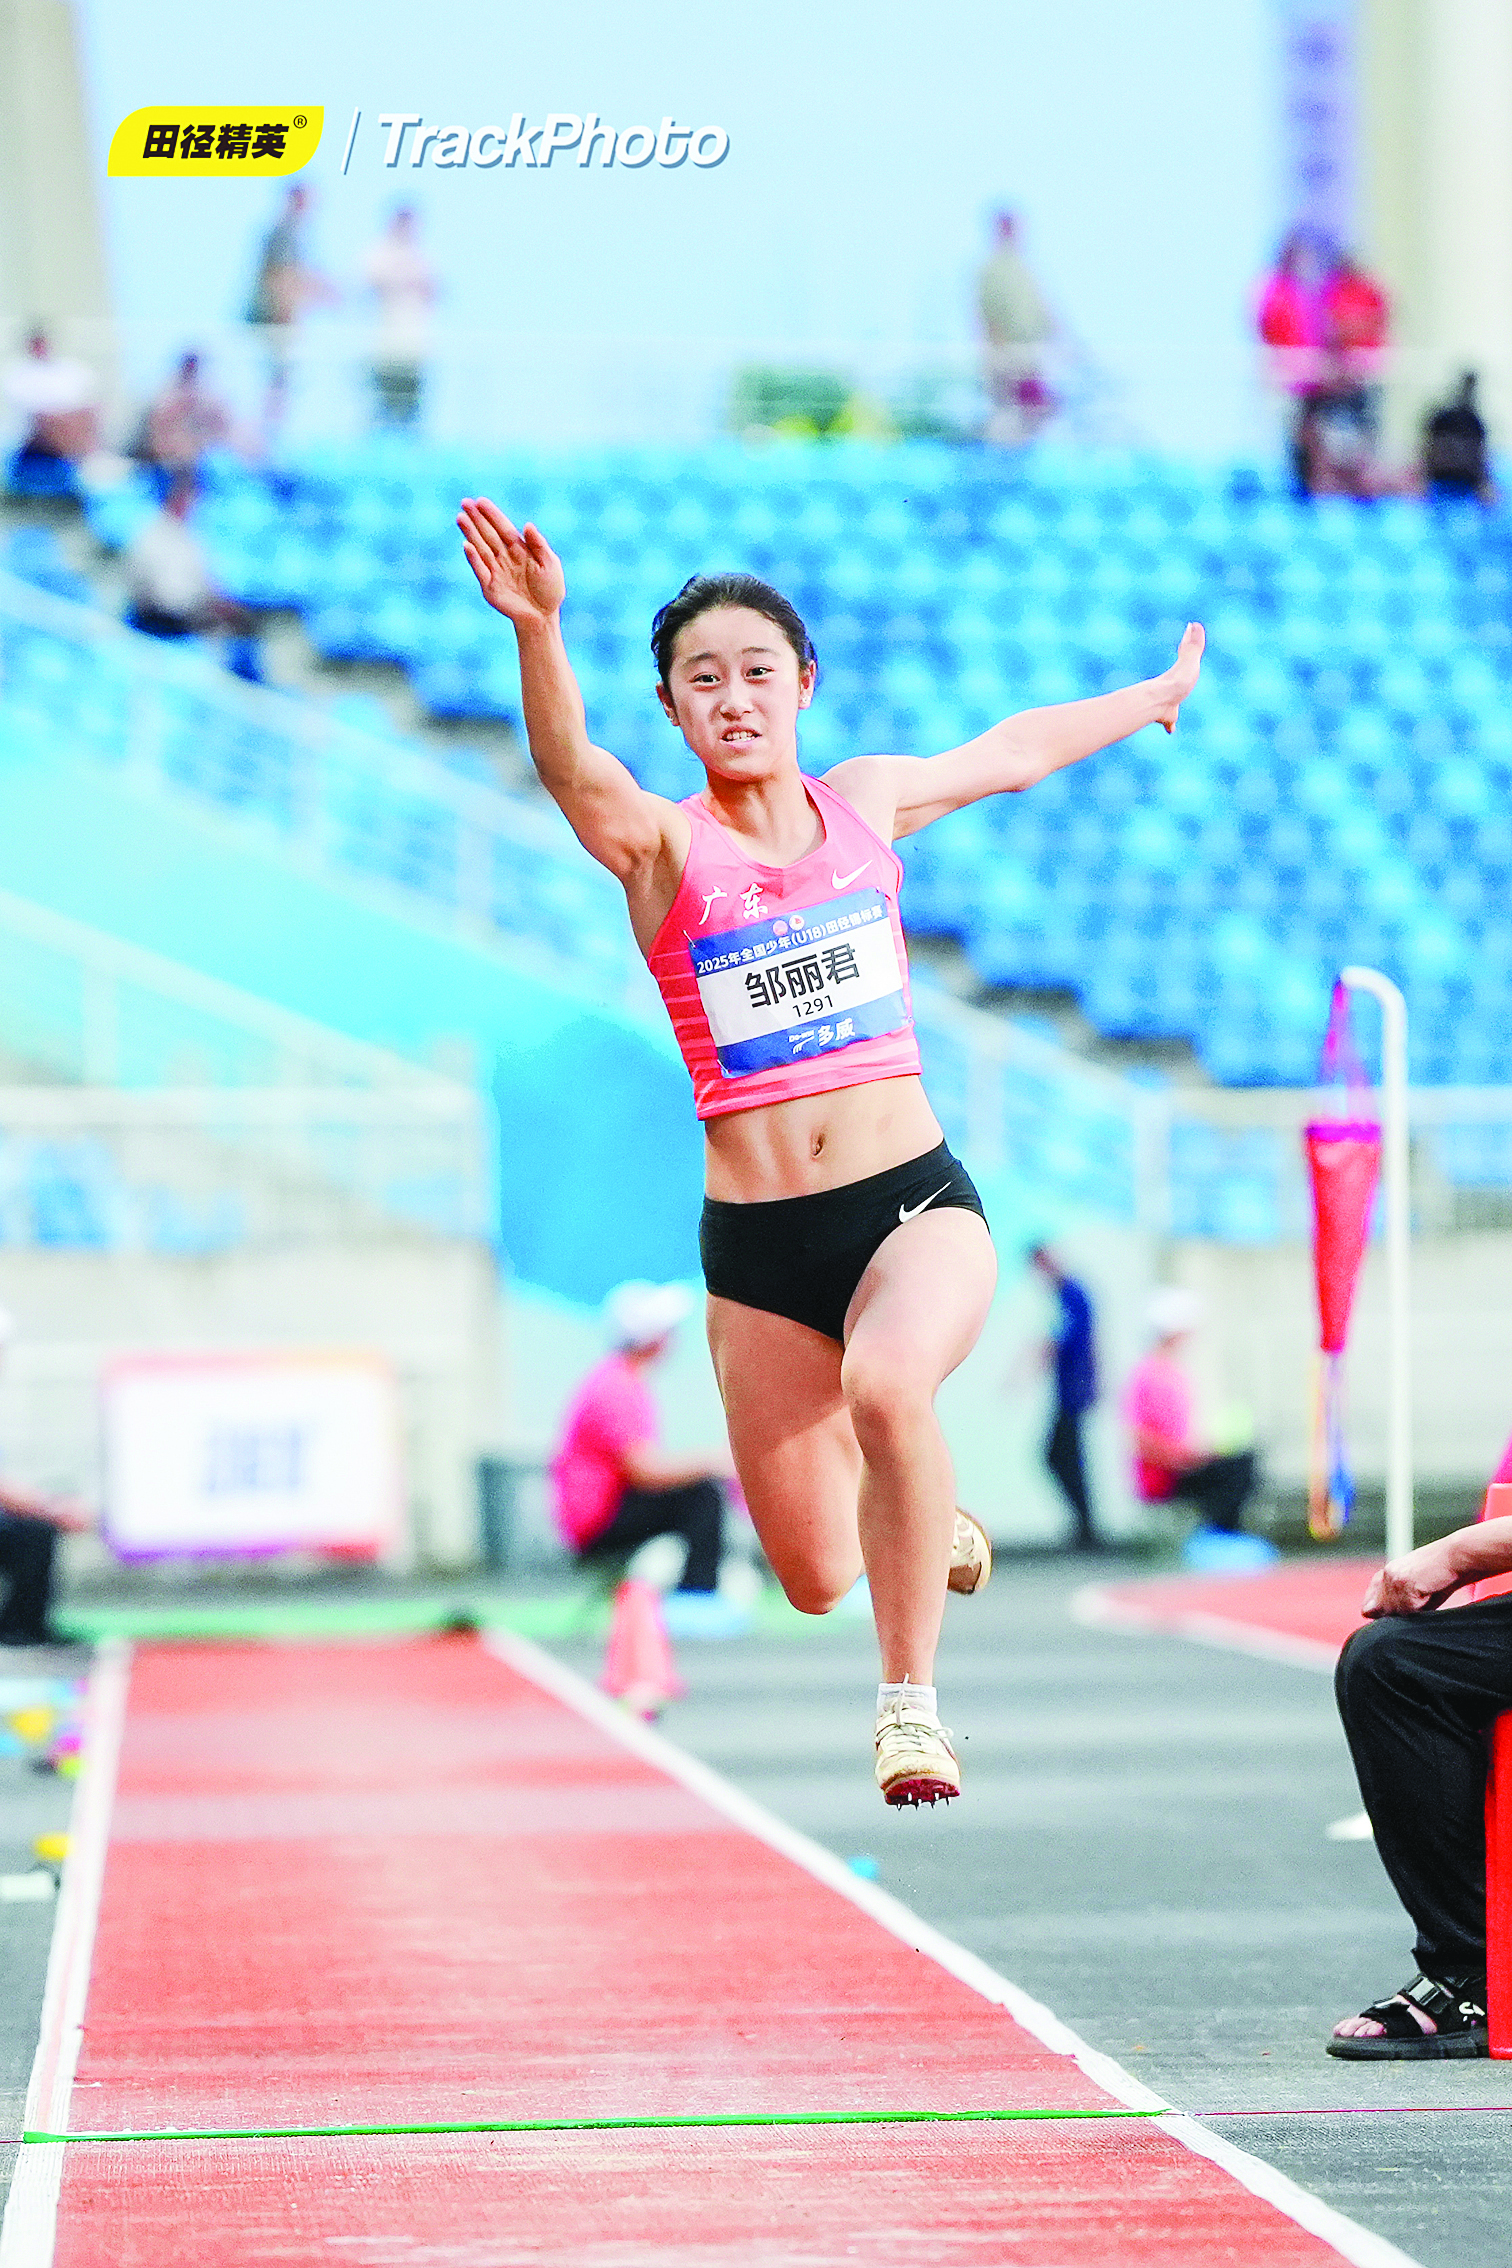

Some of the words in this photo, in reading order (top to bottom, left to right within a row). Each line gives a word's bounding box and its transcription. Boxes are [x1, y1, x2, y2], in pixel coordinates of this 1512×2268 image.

[698, 882, 769, 926] 广东
[744, 942, 860, 1009] 邹丽君
[793, 994, 834, 1018] 1291
[817, 1017, 856, 1047] 多威
